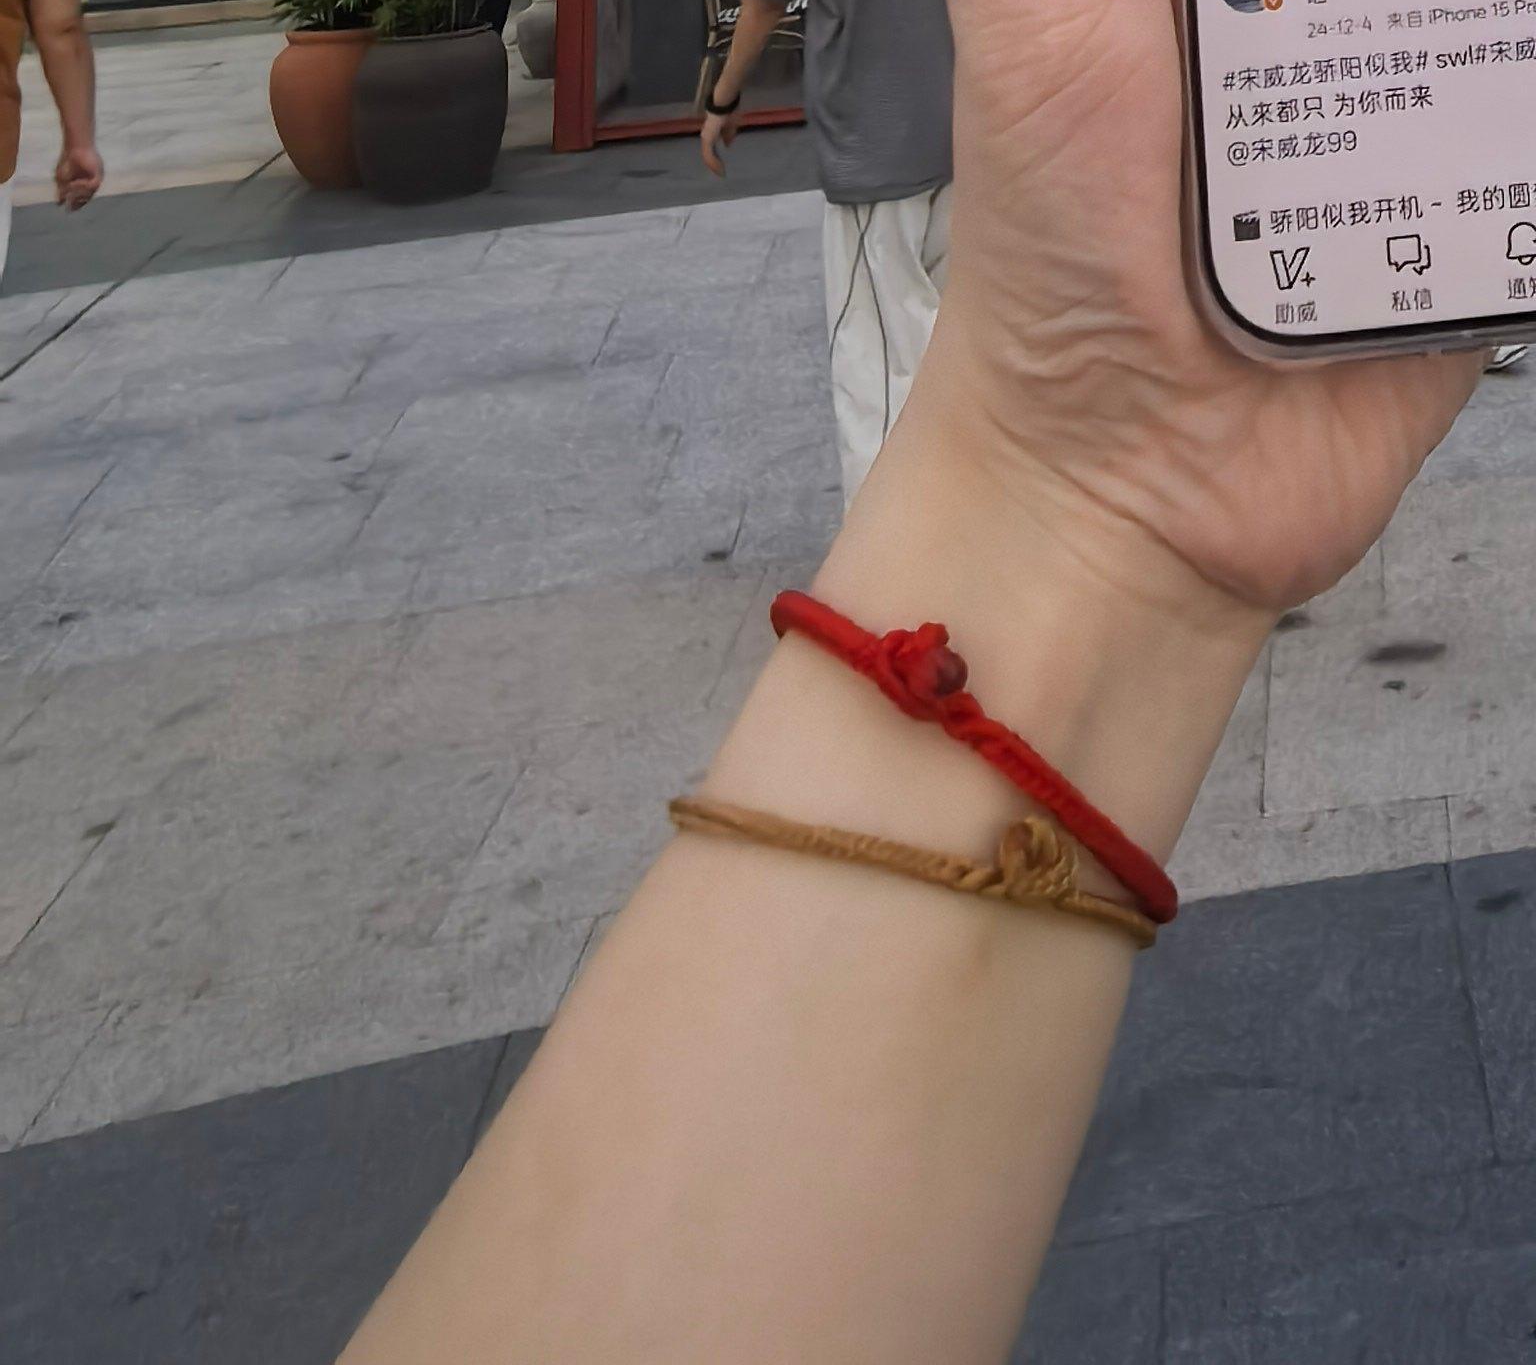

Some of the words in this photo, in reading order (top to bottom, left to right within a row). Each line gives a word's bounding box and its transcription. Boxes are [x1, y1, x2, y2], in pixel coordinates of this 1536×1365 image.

[1429, 7, 1487, 25] iPhone
[1491, 1, 1510, 18] 15
[1222, 50, 1428, 91] #宋威龙骄阳似我#
[1227, 130, 1357, 166] @宋威龙99
[1269, 195, 1424, 235] 骄阳似我开机
[1391, 288, 1433, 312] 私信
